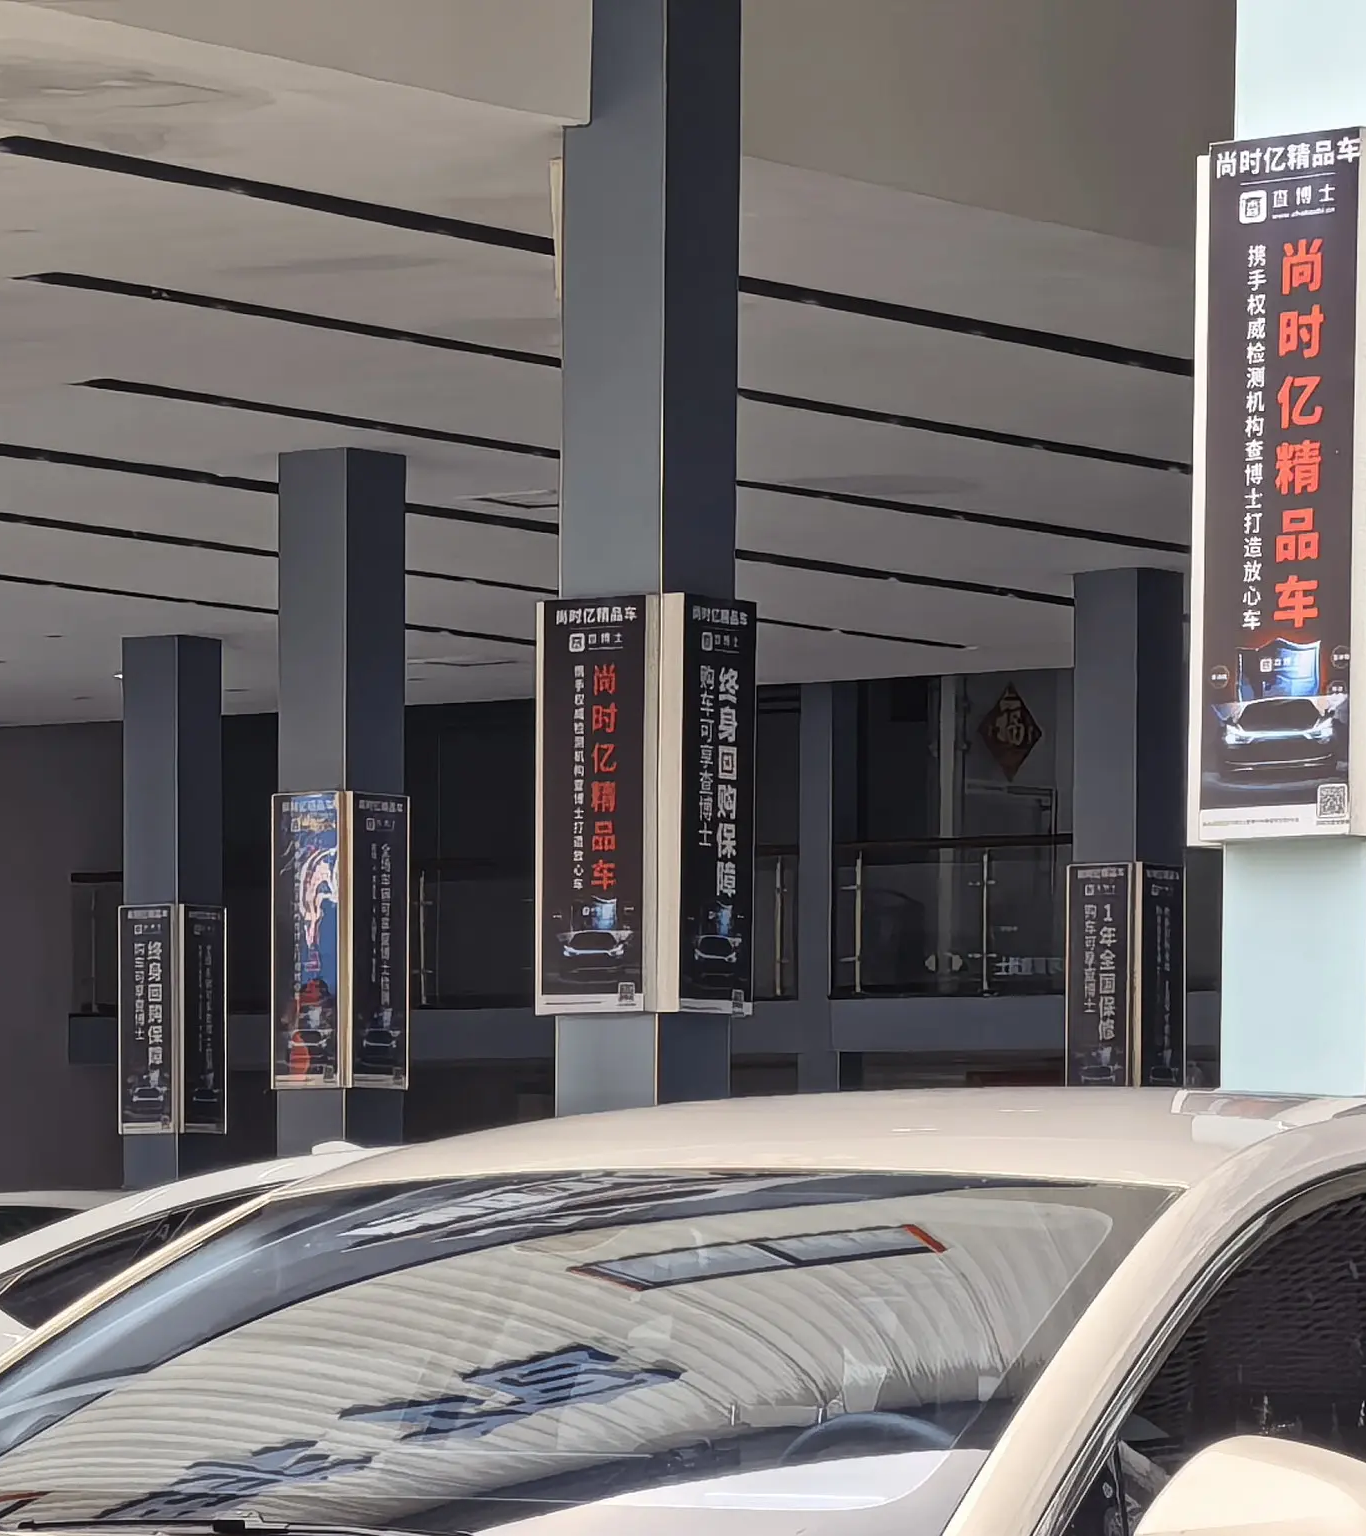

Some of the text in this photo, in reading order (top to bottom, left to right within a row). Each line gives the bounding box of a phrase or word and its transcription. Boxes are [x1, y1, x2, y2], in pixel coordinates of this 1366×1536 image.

[1216, 136, 1361, 179] 尚时亿精品车
[1242, 244, 1267, 630] 携手权威检测机构查博士打造放心车
[1273, 238, 1325, 628] 尚时亿精品车
[591, 663, 618, 890] 尚时亿精品车
[716, 667, 739, 897] 终身回购保障
